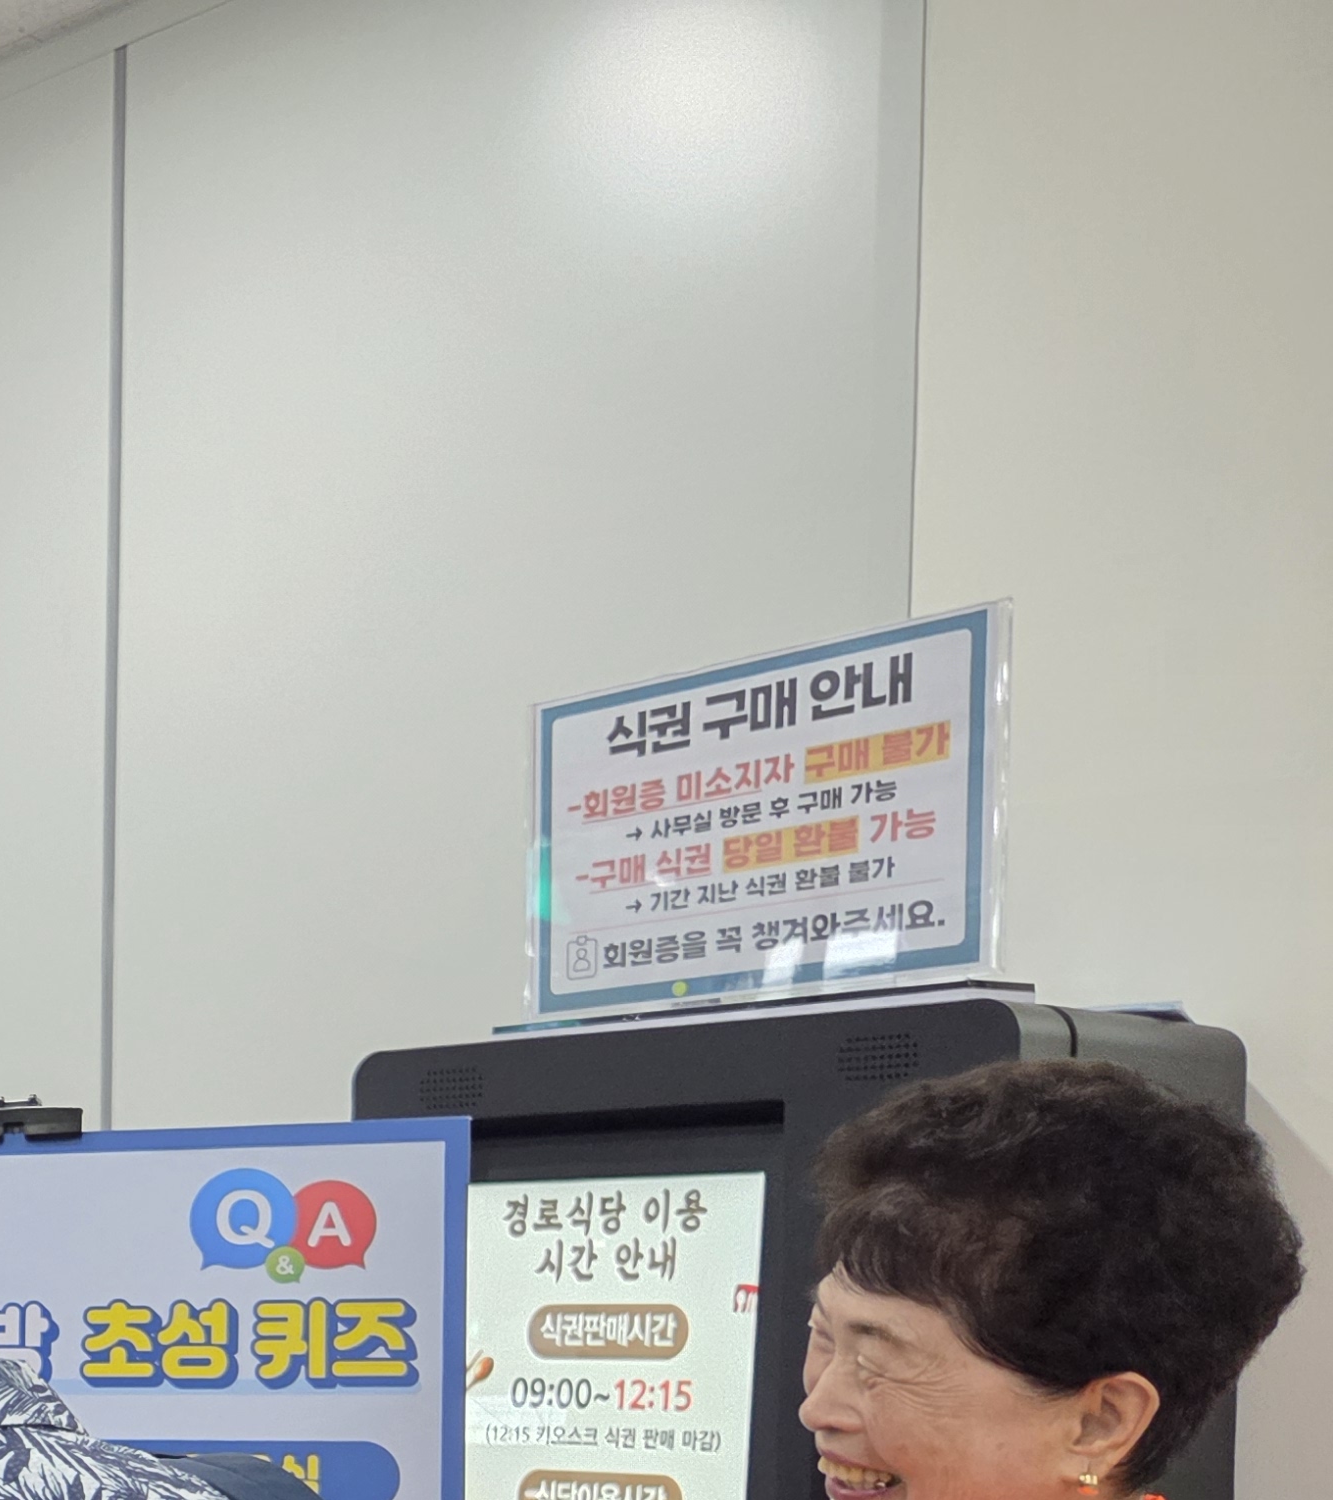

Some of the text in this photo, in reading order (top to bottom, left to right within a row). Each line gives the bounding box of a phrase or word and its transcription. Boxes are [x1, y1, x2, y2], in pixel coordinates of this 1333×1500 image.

[606, 652, 913, 757] 식권 구매 안내
[677, 754, 794, 803] 미소지자
[805, 738, 870, 783] 구매
[881, 721, 950, 766] 불가
[650, 778, 897, 841] 사무실 방문 후 구매 가능
[655, 843, 712, 880] 식권
[723, 829, 783, 870] 당일
[793, 817, 858, 858] 환불
[869, 807, 936, 844] 가능
[650, 886, 691, 912] 기간
[697, 879, 738, 906] 지난
[745, 872, 787, 900] 식권
[848, 856, 895, 884] 불가
[603, 930, 707, 968] 회원증을
[715, 925, 742, 954] 꼭
[502, 1188, 708, 1238] 경로식당 이용
[534, 1236, 677, 1283] 시간 안내
[80, 1299, 236, 1386] 초성
[254, 1296, 417, 1387] 퀴즈
[539, 1311, 677, 1349] 식권판매시간
[510, 1376, 693, 1412] 09:00~12:15
[485, 1424, 722, 1452] (12:15 키오스크 식권 판매 마감)
